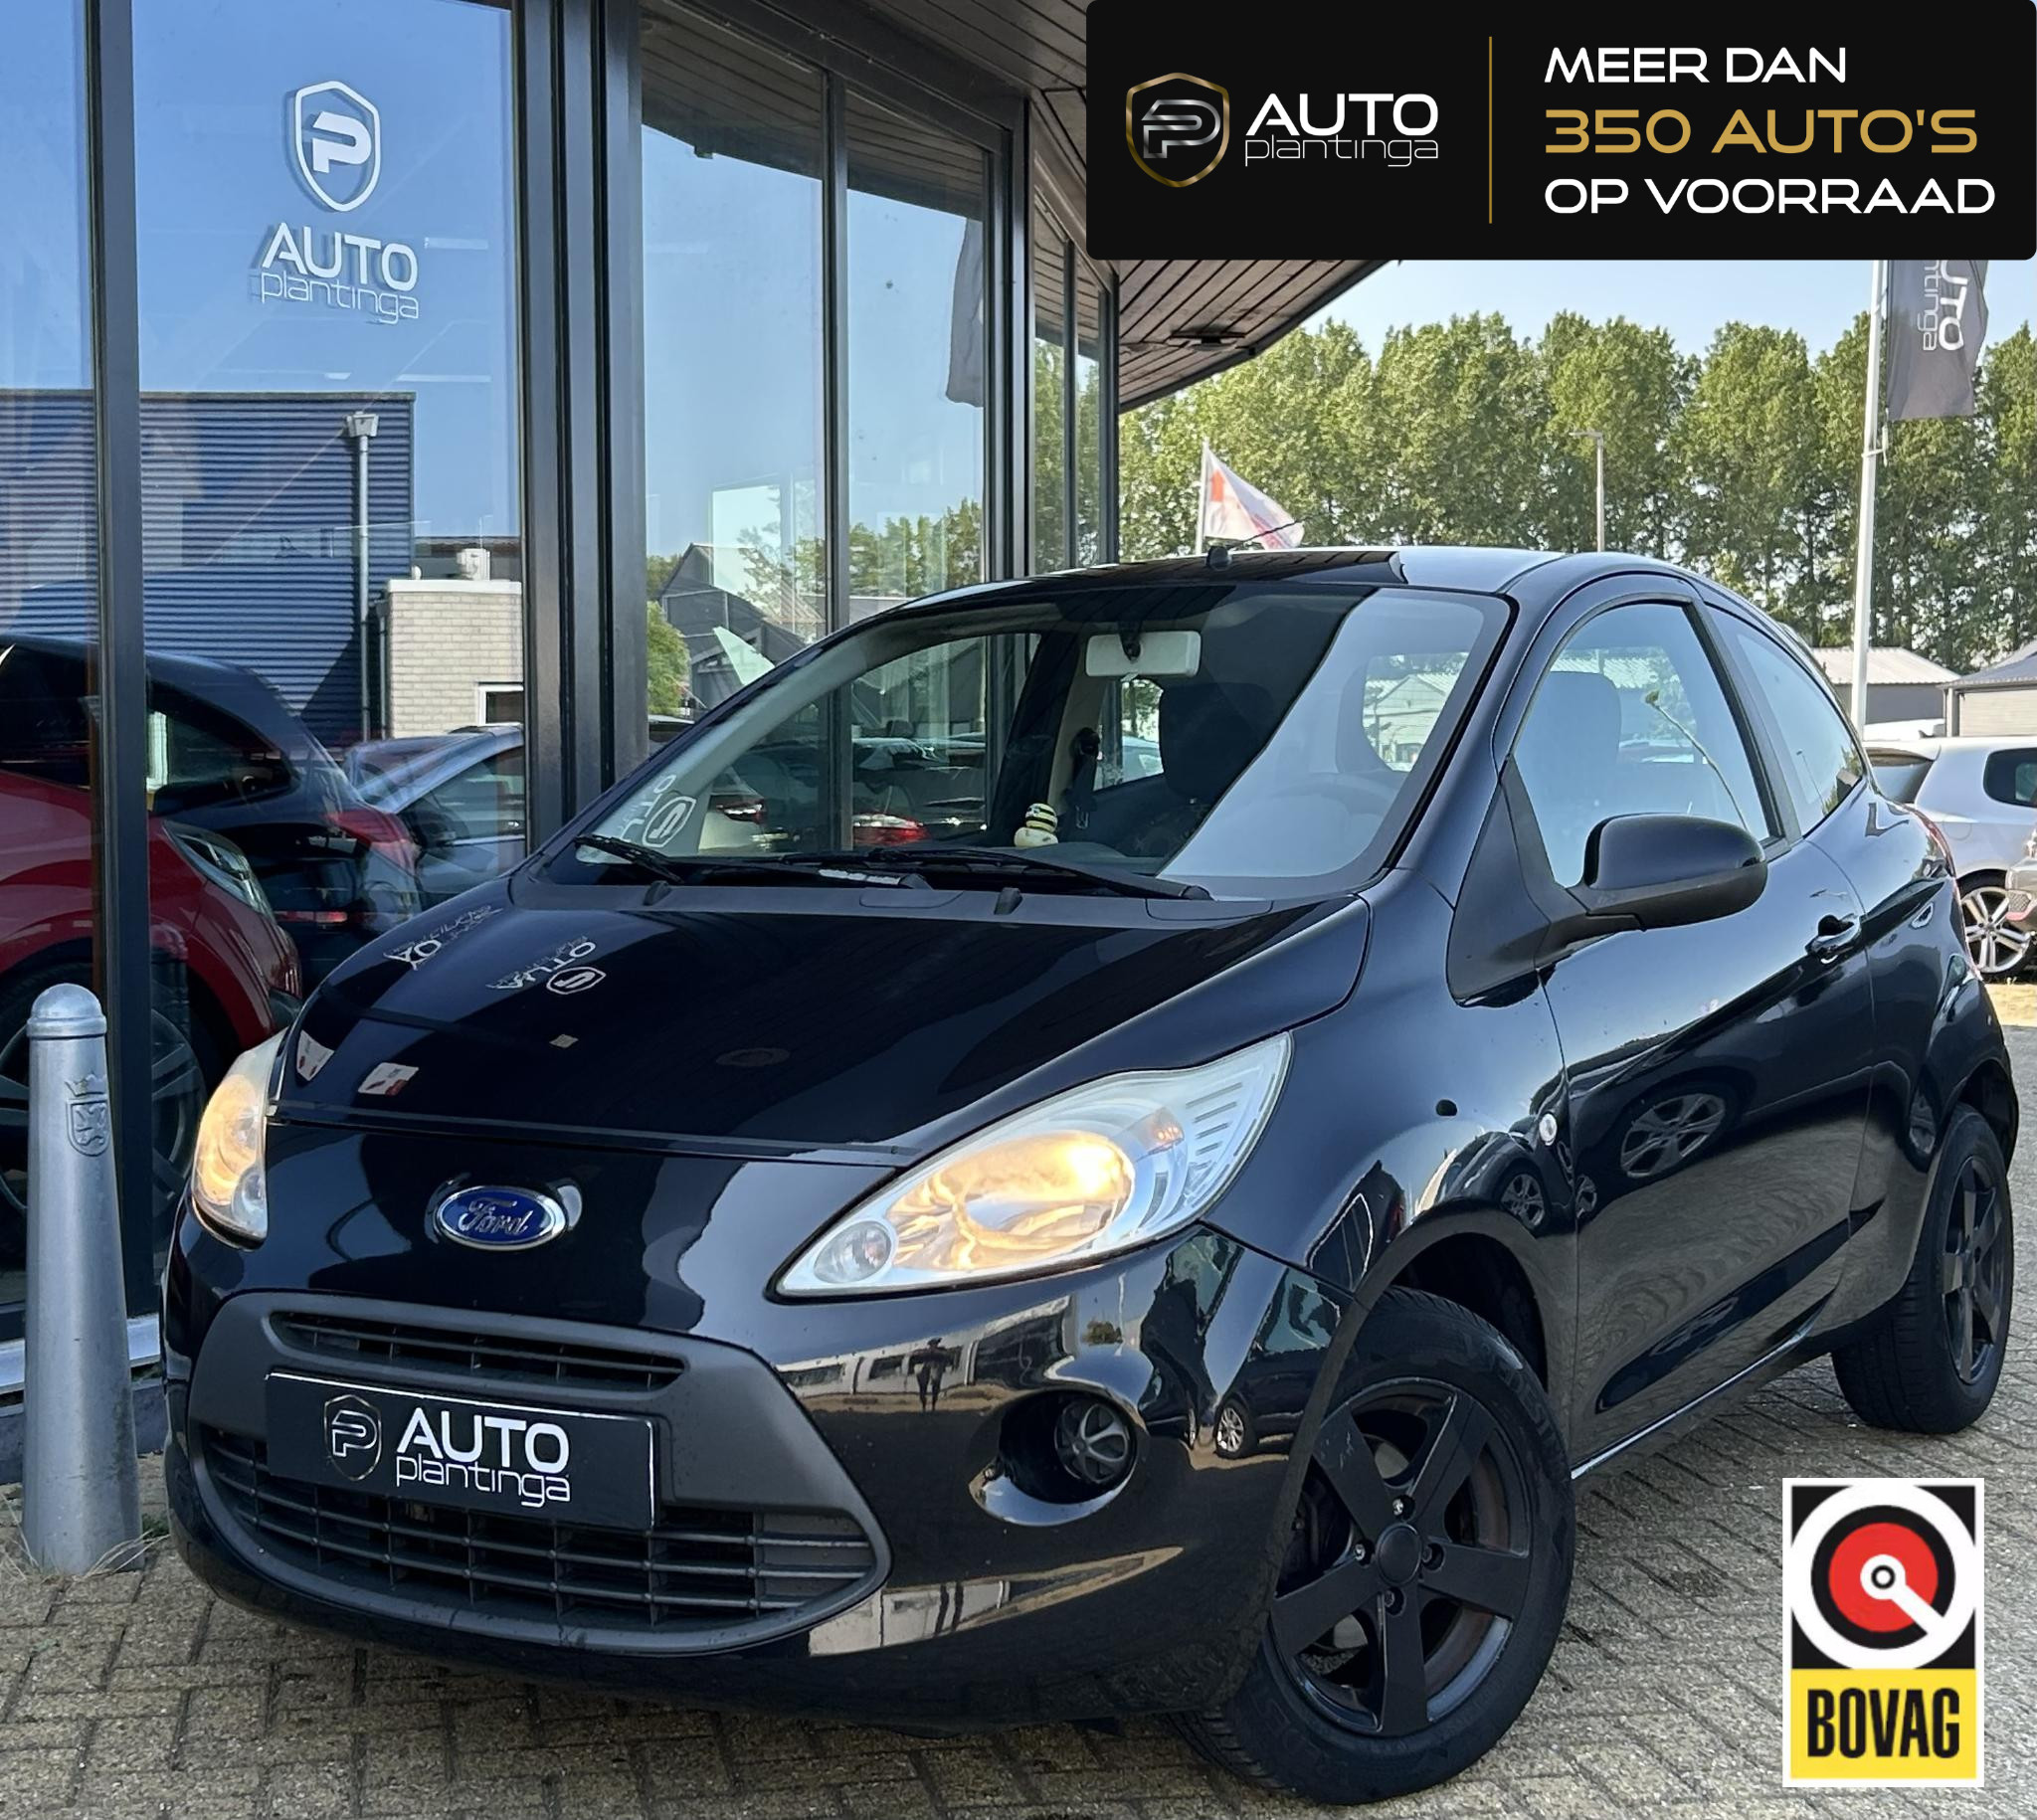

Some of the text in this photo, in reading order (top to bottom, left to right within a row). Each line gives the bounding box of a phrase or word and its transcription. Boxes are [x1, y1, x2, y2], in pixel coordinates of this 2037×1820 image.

[262, 222, 419, 291] AUTO
[261, 271, 419, 325] plantinga
[1939, 260, 1968, 351] UTO
[458, 1196, 534, 1235] Ford
[396, 1407, 570, 1474] AUTO
[396, 1453, 571, 1508] plantinga
